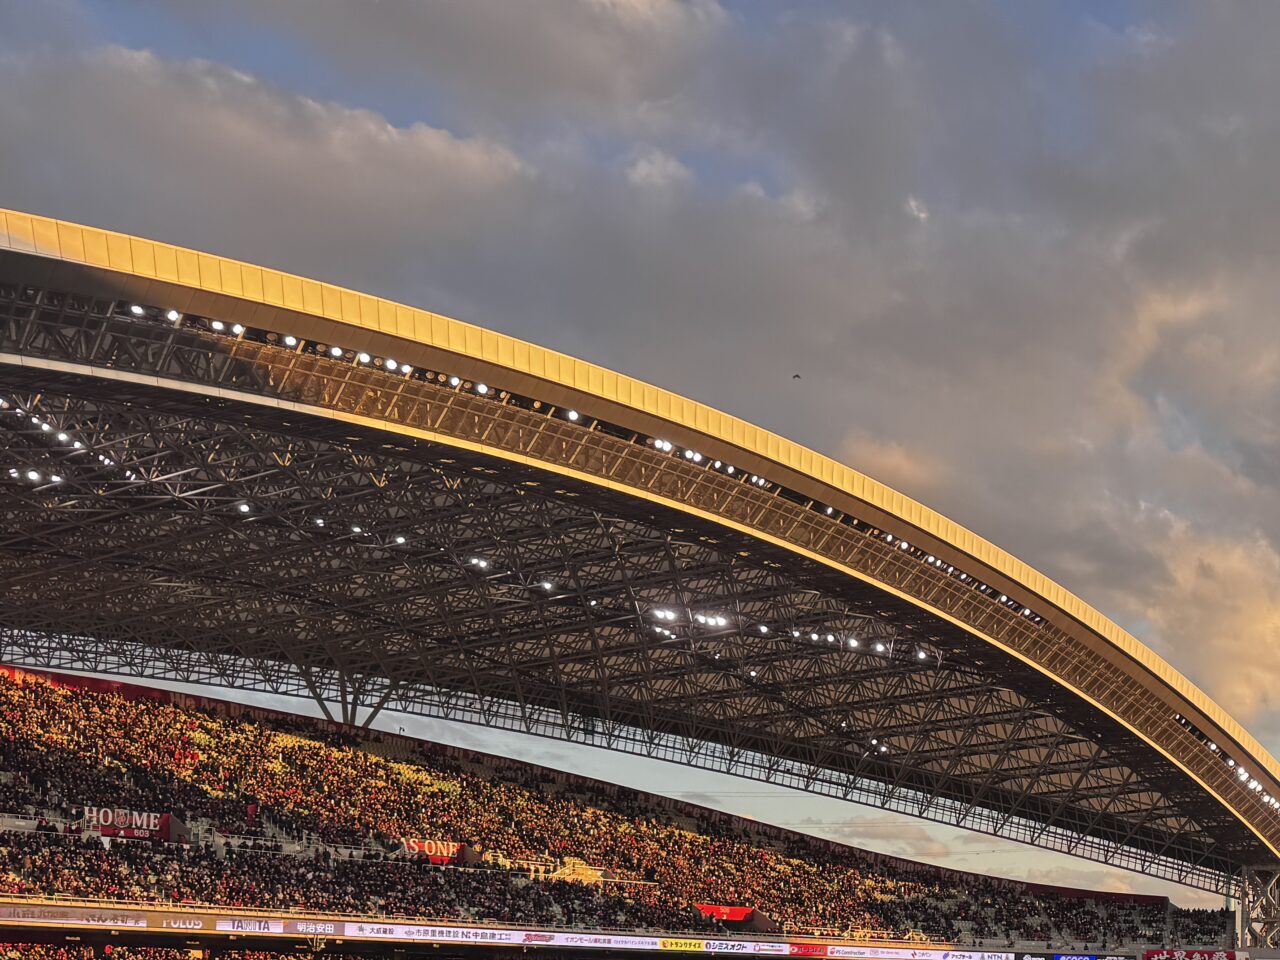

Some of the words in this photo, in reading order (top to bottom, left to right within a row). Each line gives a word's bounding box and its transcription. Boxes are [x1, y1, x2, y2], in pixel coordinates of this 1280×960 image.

[84, 806, 160, 831] HOME
[424, 840, 458, 857] ONE
[231, 920, 271, 932] TANITA
